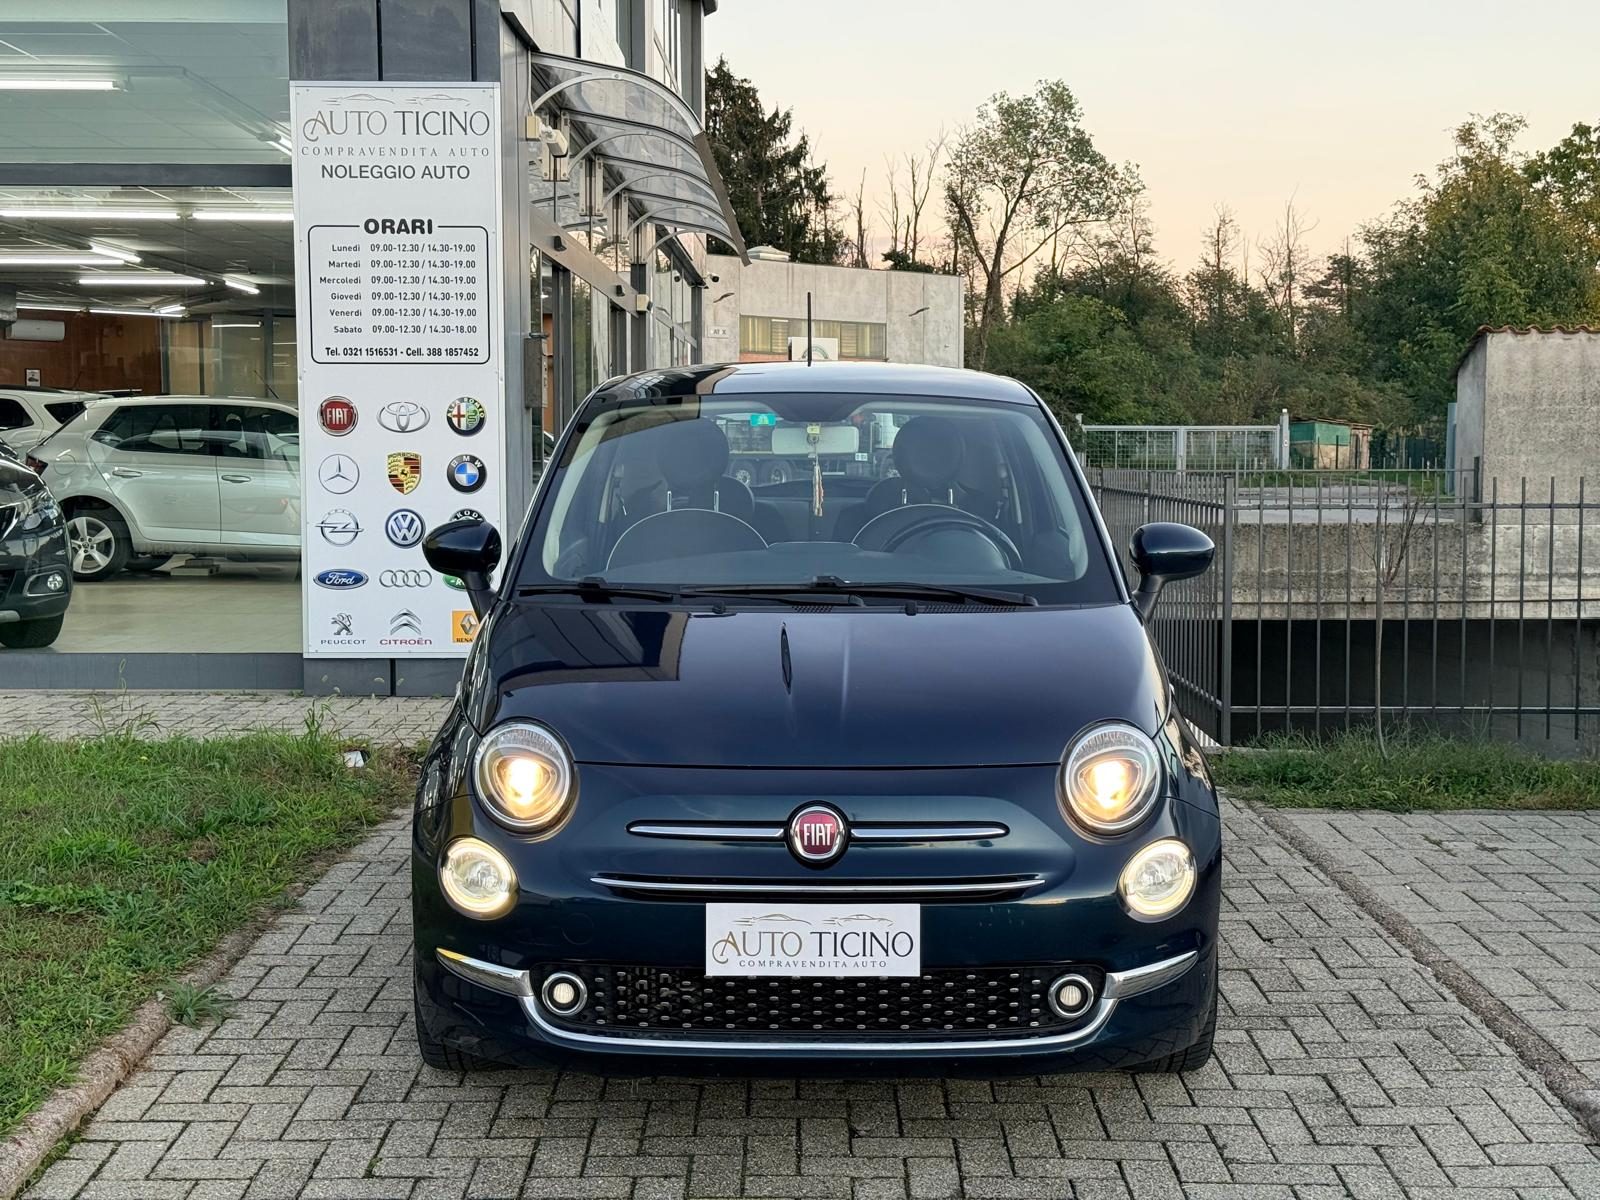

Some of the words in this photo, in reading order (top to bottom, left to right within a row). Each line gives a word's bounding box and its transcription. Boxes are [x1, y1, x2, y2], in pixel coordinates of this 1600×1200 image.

[303, 110, 388, 142] AUTO
[393, 110, 490, 136] TICINO
[301, 146, 438, 157] COMPRAVENDITA
[448, 147, 490, 157] AUTO
[321, 164, 416, 180] NOLEGGIO
[420, 165, 471, 180] AUTO
[363, 218, 433, 235] ORARI
[370, 243, 420, 252] 09.00-12.30
[427, 243, 476, 252] 14.30-19.00
[370, 260, 420, 268] 09.00-12.30
[428, 260, 476, 268] 14.30-19.00
[371, 276, 420, 284] 09.00-12.30
[428, 276, 476, 284] 14.30-19.00
[371, 292, 420, 301] 09.00-12.30
[428, 292, 477, 301] 14.30-19.00
[372, 308, 421, 317] 09.00-12.30
[429, 308, 477, 317] 14.30-19.00
[372, 325, 421, 334] 09.00-12.30
[429, 325, 477, 334] 14.30-18.00
[325, 347, 341, 357] Tel.
[343, 347, 362, 357] 0321
[365, 347, 398, 357] 1516531
[405, 347, 424, 357] Cell.
[426, 347, 442, 357] 388
[444, 347, 479, 357] 1857452
[463, 397, 485, 418] ROMEO
[326, 409, 349, 425] FIAT
[451, 455, 483, 468] BMW
[451, 510, 482, 520] KOD
[325, 572, 355, 585] Ford
[803, 823, 833, 846] FIAT
[712, 931, 803, 965] AUTO
[809, 931, 914, 958] TICINO
[739, 959, 848, 968] COMPRAVENDITA
[853, 960, 887, 968] AUTO
